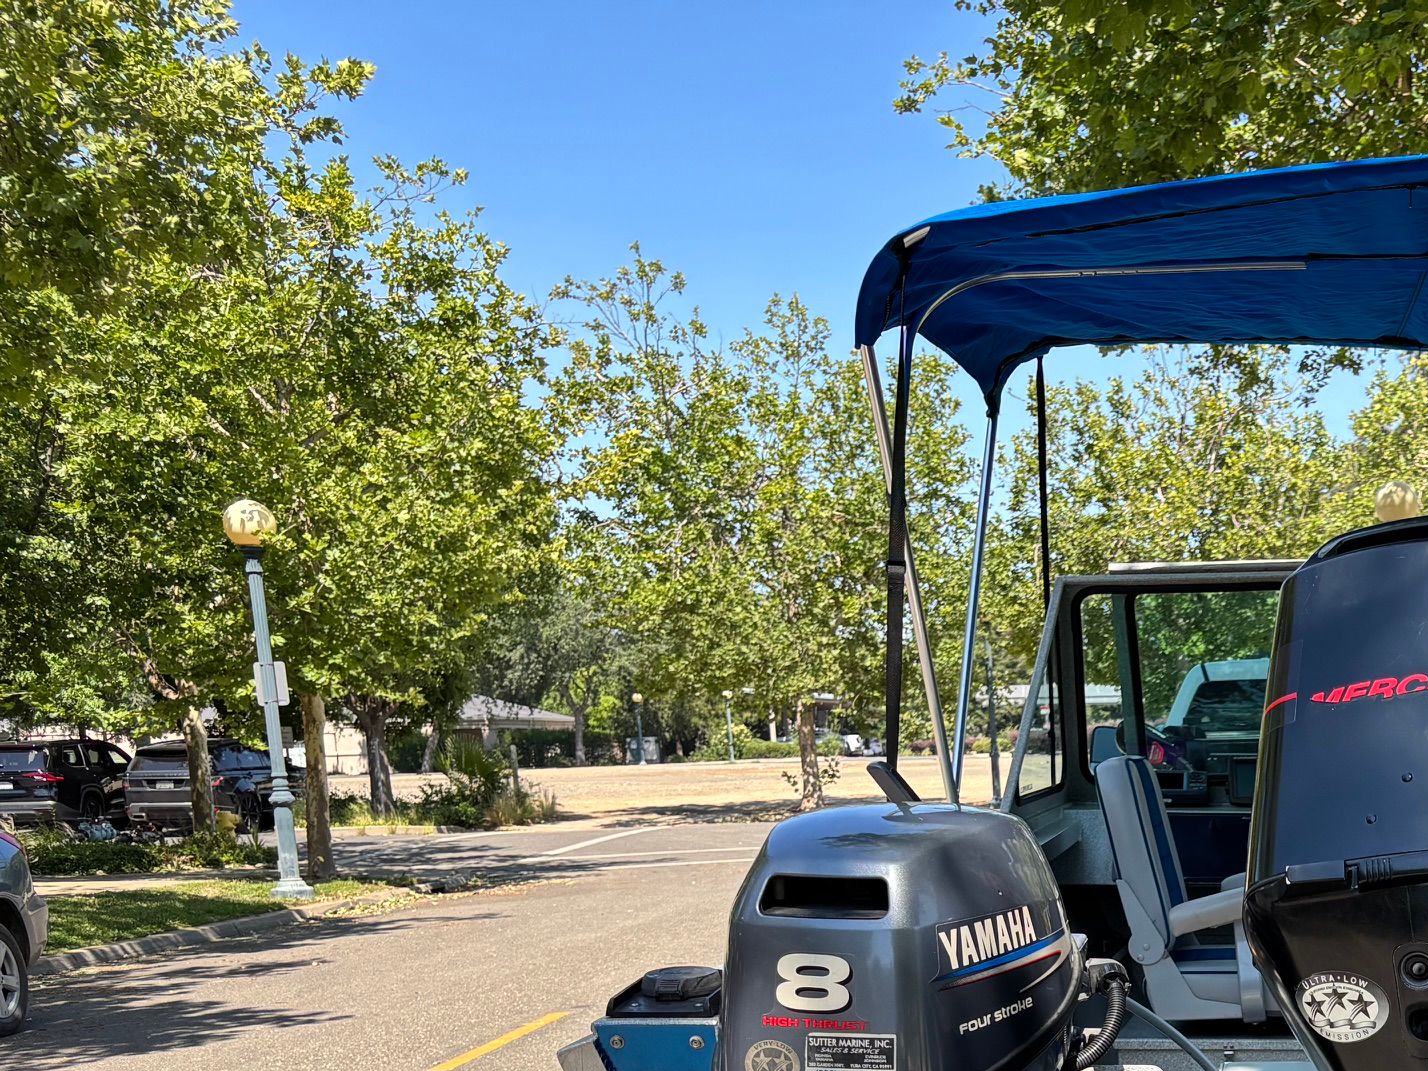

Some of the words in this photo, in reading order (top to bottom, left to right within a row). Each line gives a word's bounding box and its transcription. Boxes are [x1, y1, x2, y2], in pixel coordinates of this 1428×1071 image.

[938, 905, 1037, 970] YAMAHA
[776, 953, 853, 1014] 8
[762, 1015, 799, 1028] HIGH
[802, 1018, 866, 1031] THRUST
[809, 1037, 837, 1047] SUTTER
[839, 1039, 873, 1049] MARINE,
[874, 1040, 892, 1049] INC.
